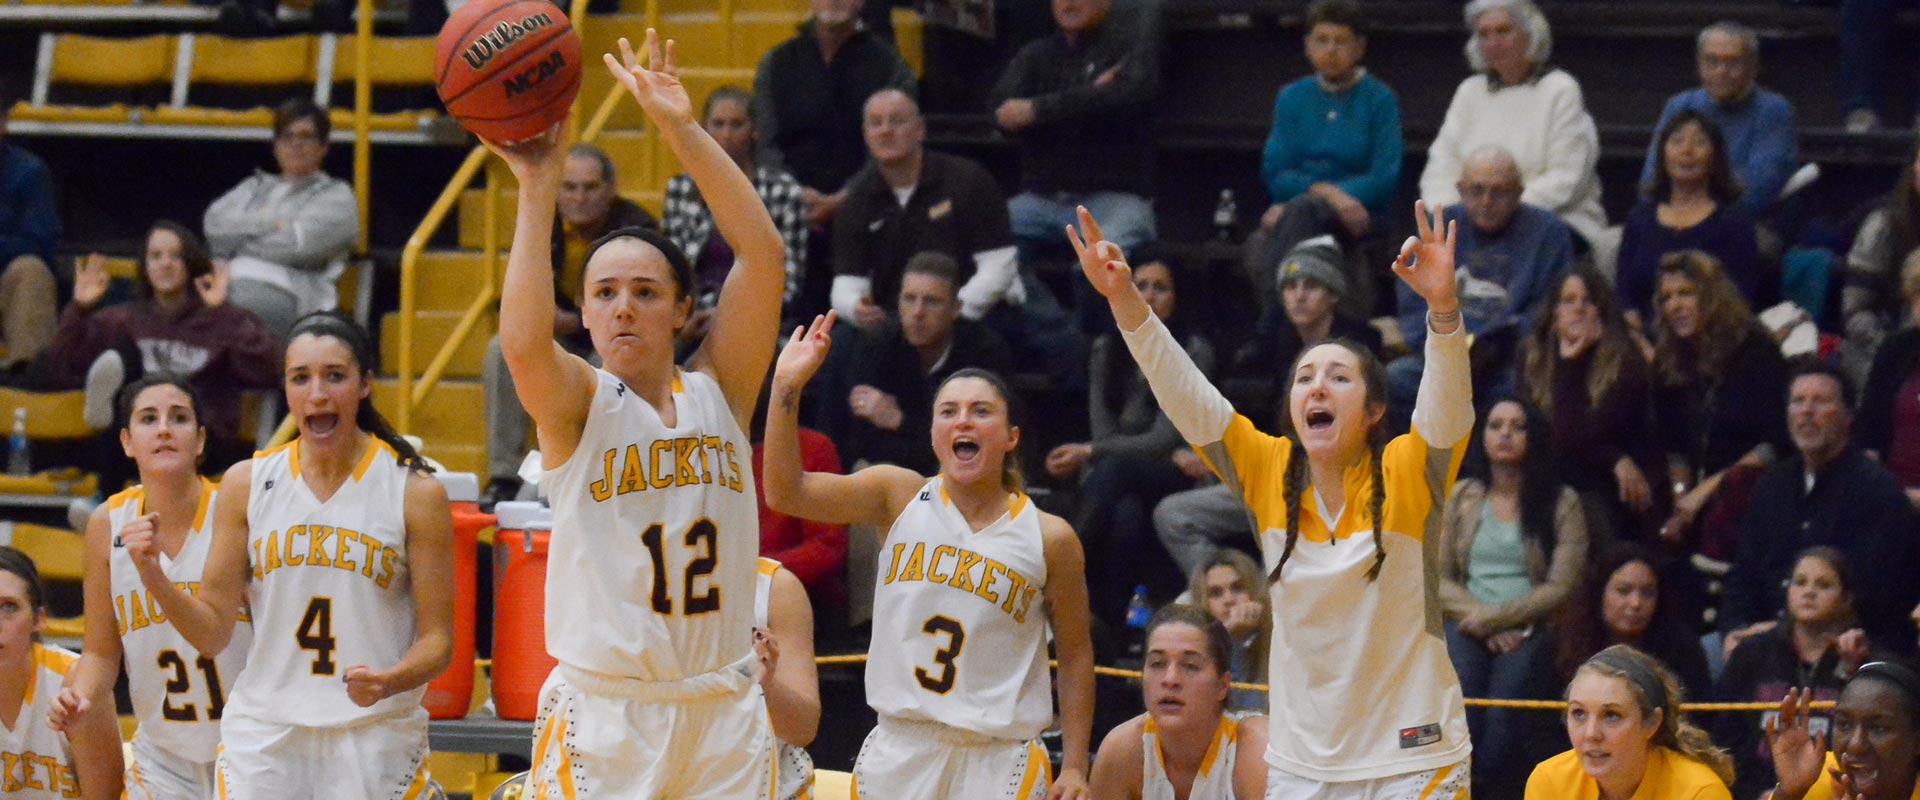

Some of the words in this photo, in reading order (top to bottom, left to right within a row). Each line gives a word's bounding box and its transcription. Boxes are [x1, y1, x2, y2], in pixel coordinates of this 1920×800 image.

[461, 12, 553, 70] Wilson
[503, 50, 566, 98] NCAA
[252, 524, 399, 589] JACKETS
[641, 516, 721, 616] 12
[883, 542, 1038, 624] JACKETS
[295, 595, 336, 677] 4
[914, 613, 966, 696] 3
[157, 648, 226, 722] 21
